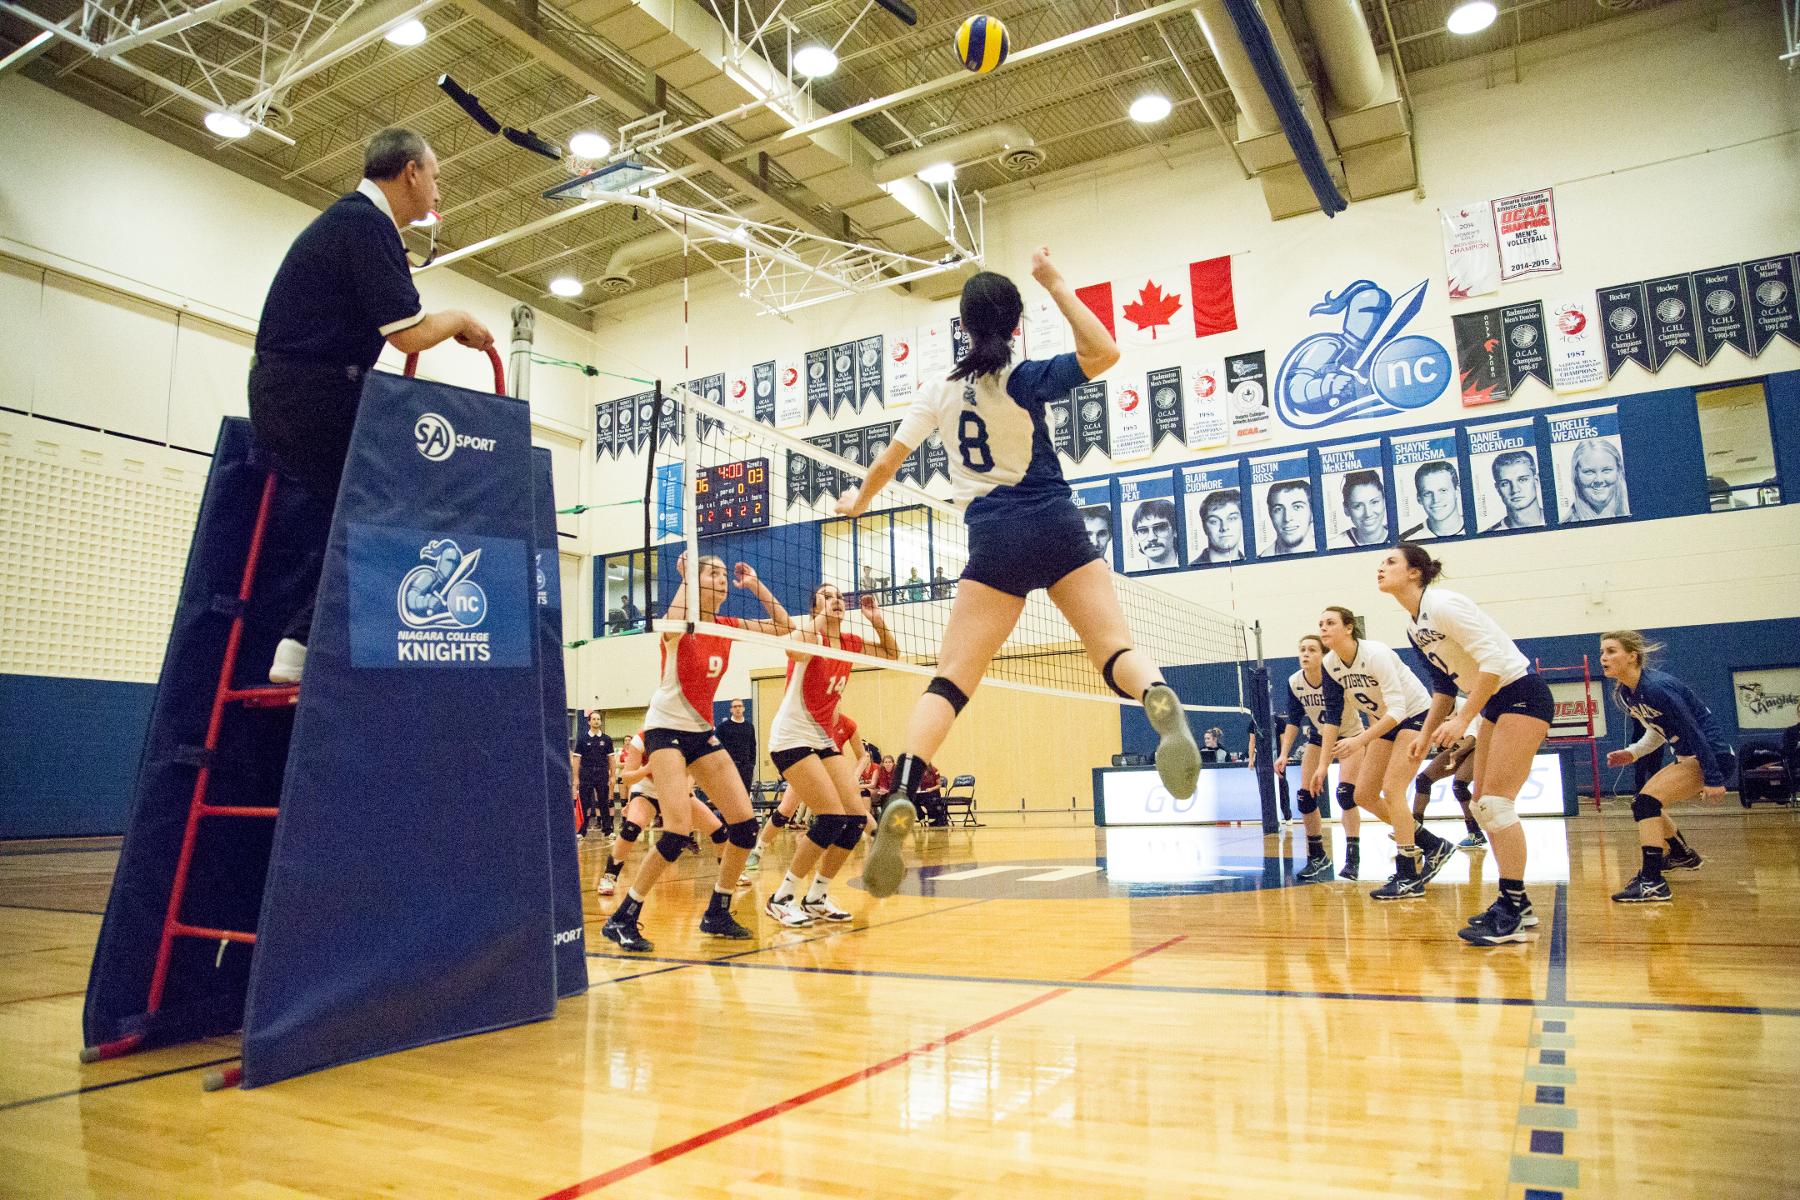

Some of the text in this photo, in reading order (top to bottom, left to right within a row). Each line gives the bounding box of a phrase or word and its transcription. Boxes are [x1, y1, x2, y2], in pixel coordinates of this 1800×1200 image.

[1502, 204, 1547, 223] OCAA
[1502, 217, 1550, 235] CHAMPIONS
[1507, 234, 1547, 247] VOLLEYBALL
[1515, 229, 1537, 239] MEN'S
[1450, 243, 1489, 255] CHAMPION
[1511, 259, 1550, 271] 2014-2015
[1753, 261, 1783, 273] Curling
[1705, 274, 1728, 285] Hockey
[1760, 269, 1778, 278] Mixed
[1656, 284, 1679, 294] Hockey
[1609, 291, 1631, 302] Hockey
[1506, 306, 1537, 317] Badminton
[1504, 313, 1540, 324] Men's Doubles
[1758, 314, 1793, 325] Champions
[1708, 323, 1741, 333] Champions
[1658, 331, 1690, 342] Champions
[1611, 339, 1642, 351] Champions
[1512, 356, 1542, 367] Champions
[1567, 351, 1586, 359] 1987
[1152, 372, 1177, 381] Badminton
[1387, 356, 1439, 388] nc
[1559, 369, 1597, 378] CHAMPIONS
[1550, 417, 1590, 433] LORELLE
[1469, 431, 1501, 444] DANIEL
[1552, 426, 1599, 443] WEAVERS
[456, 434, 497, 452] SPORT
[958, 410, 996, 474] 8
[1394, 441, 1430, 455] SHAYNE
[1471, 437, 1524, 455] GROENVELD
[1321, 451, 1355, 465] KAITLYN
[1396, 451, 1446, 465] PETRUSMA
[718, 463, 743, 480] 4:00
[1251, 462, 1279, 475] JUSTIN
[1323, 459, 1363, 474] McKENNA
[748, 468, 763, 484] 03
[1185, 473, 1208, 485] BLAIR
[1253, 473, 1275, 484] ROSS
[695, 478, 709, 494] 06
[738, 483, 744, 494] 0
[1121, 483, 1138, 493] TOM
[1185, 479, 1223, 493] CUDMORE
[1121, 492, 1141, 502] PEAT
[740, 505, 747, 516] 2
[754, 503, 761, 514] 2
[454, 595, 479, 613] nc
[397, 631, 490, 642] NIAGARA COLLEGE
[397, 642, 492, 662] KNIGHTS
[706, 655, 723, 678] 9
[826, 676, 846, 695] 14
[1354, 692, 1379, 712] 9
